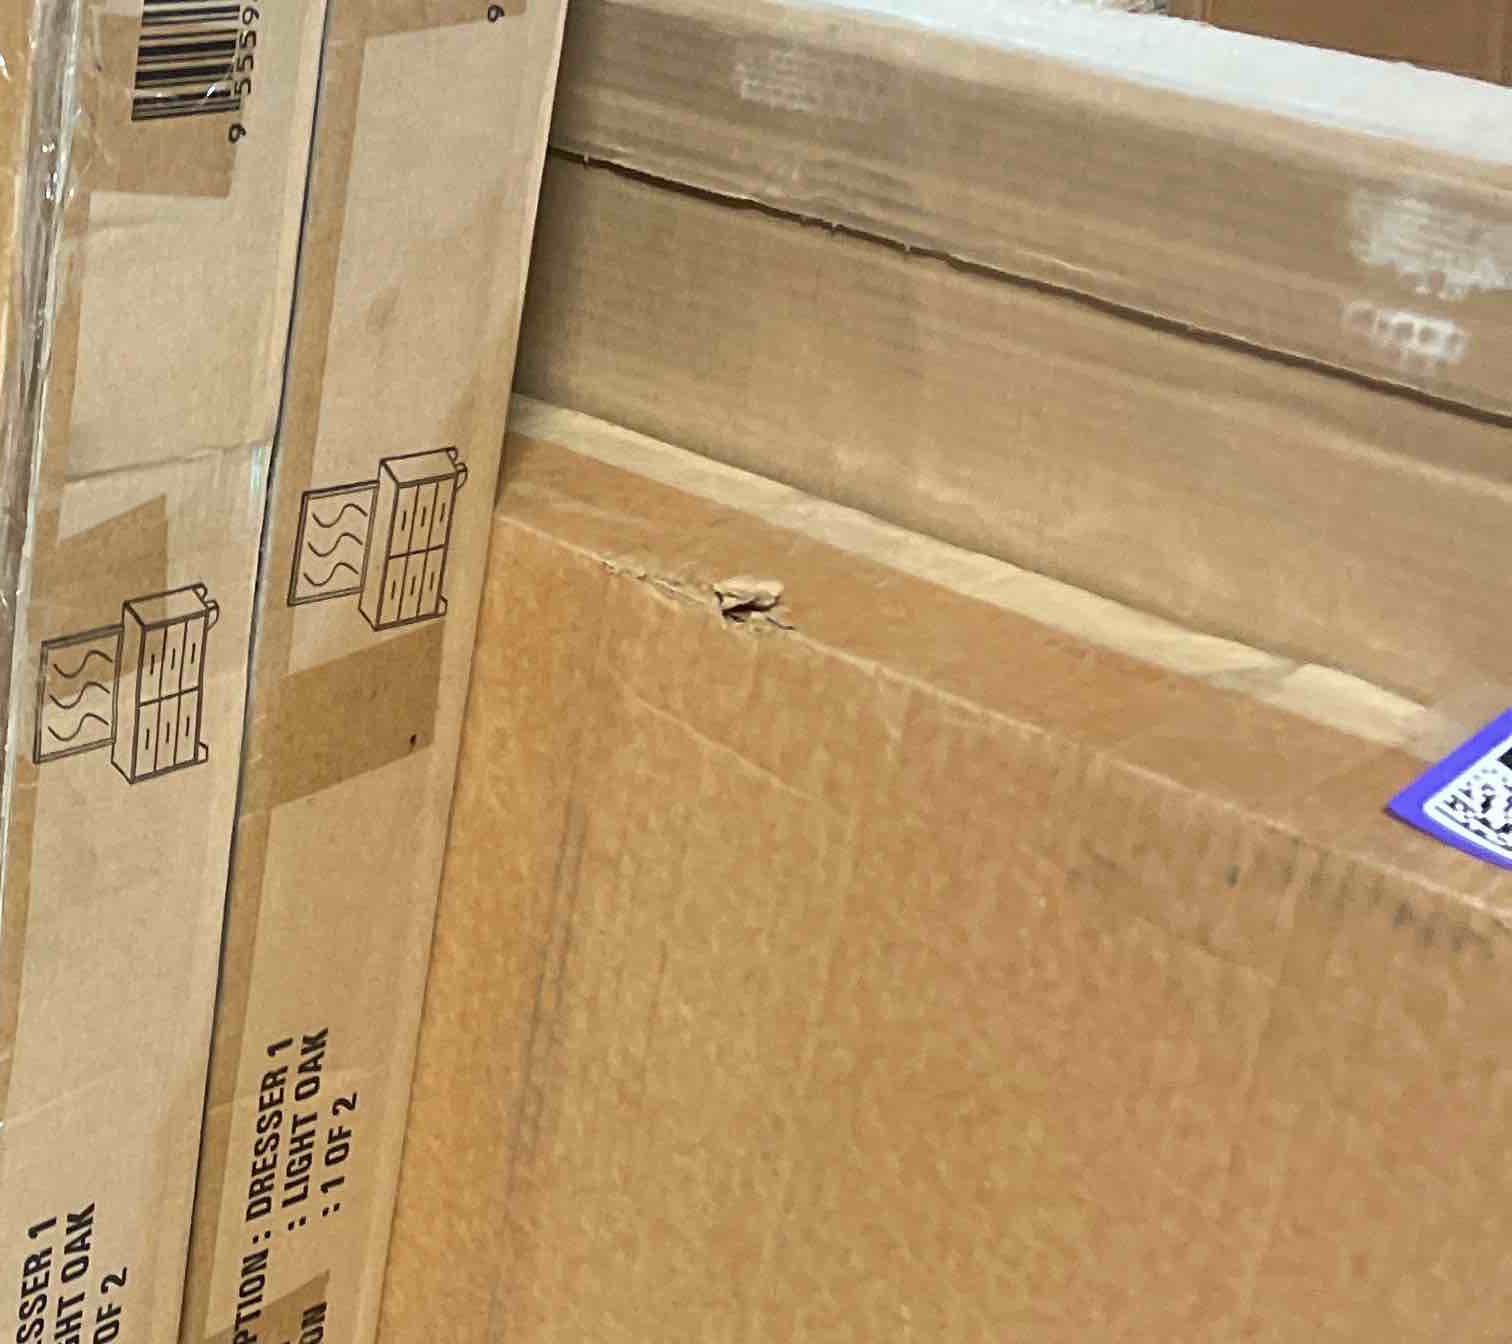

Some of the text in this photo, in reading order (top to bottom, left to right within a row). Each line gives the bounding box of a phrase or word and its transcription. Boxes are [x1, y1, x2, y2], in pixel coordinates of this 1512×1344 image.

[488, 4, 505, 22] 9
[229, 123, 246, 144] 9
[295, 1028, 328, 1101] OAK
[332, 1092, 357, 1116] 2
[246, 1066, 288, 1222] DRESSER
[267, 1038, 293, 1057] 1
[282, 1112, 317, 1208] LIGHT
[325, 1126, 352, 1167] OF
[320, 1176, 344, 1194] 1
[28, 1216, 57, 1239] 1
[61, 1203, 95, 1284] OAK
[101, 1267, 127, 1294] 2
